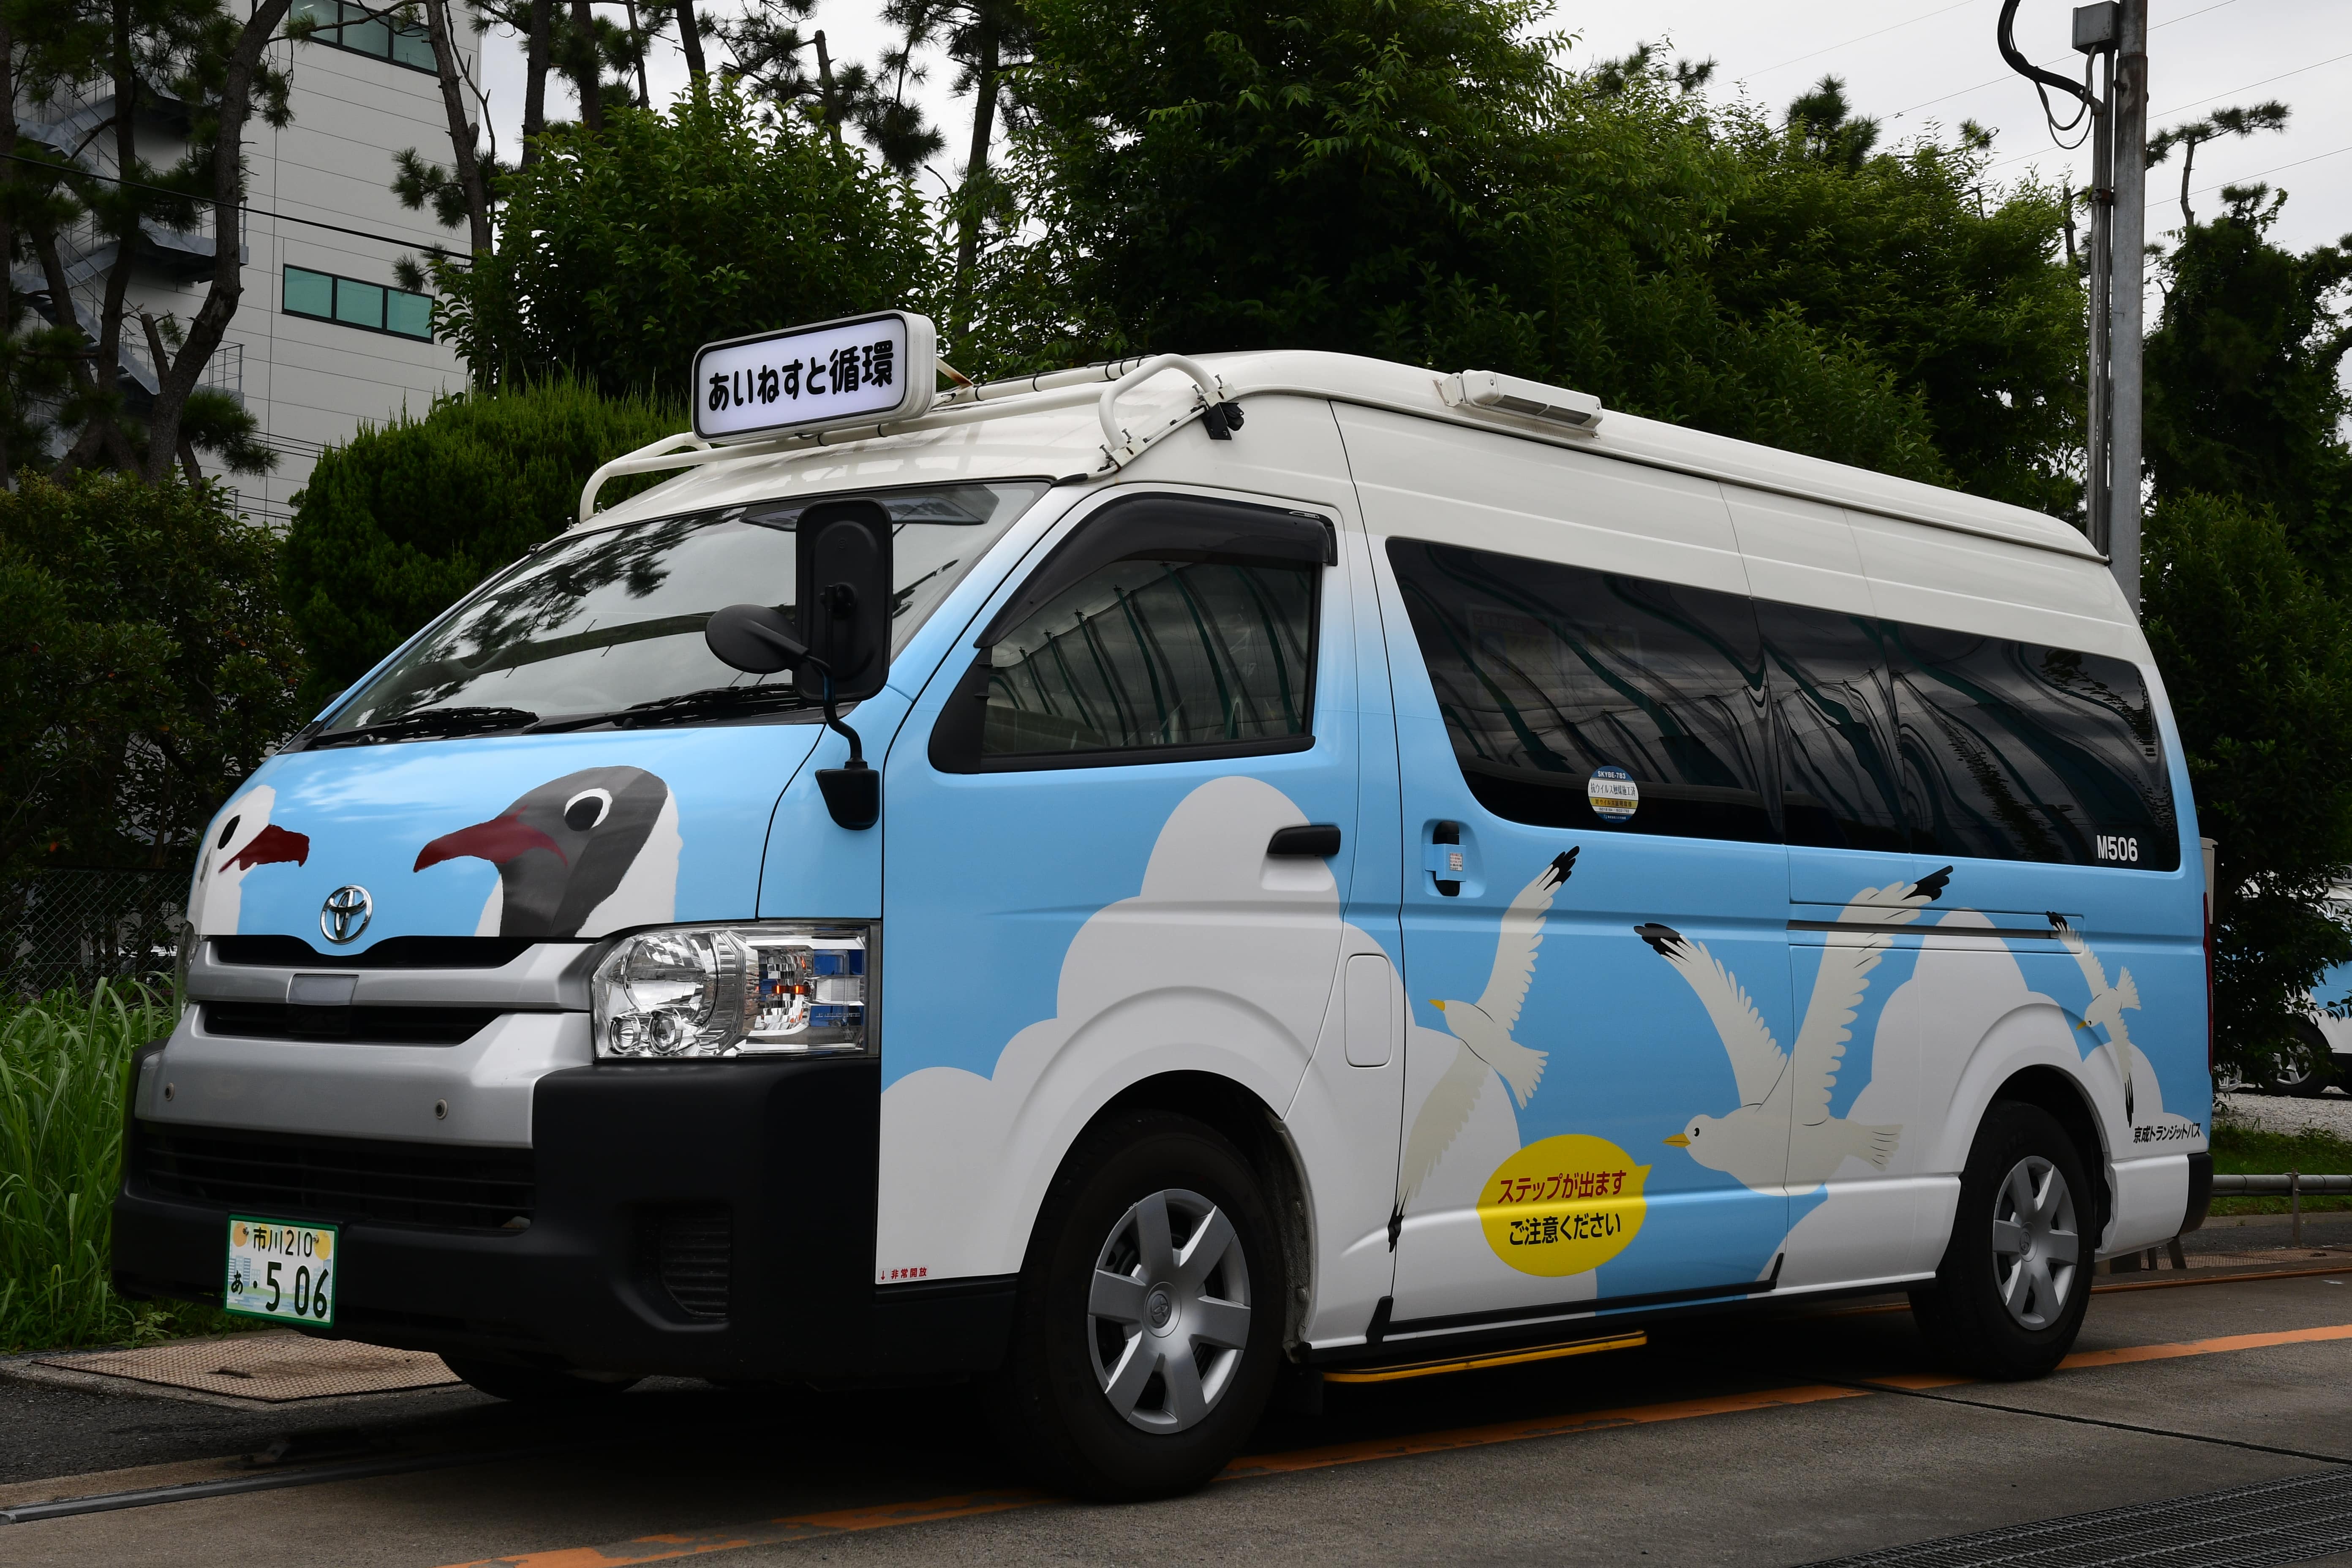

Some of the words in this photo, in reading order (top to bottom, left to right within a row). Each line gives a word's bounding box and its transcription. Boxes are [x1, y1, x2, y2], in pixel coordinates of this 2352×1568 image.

[708, 340, 894, 411] あいねすと循環
[1598, 771, 1626, 779] SKYBE-783
[2096, 835, 2138, 862] M506
[2133, 1122, 2201, 1144] 京成トランジットバス
[1497, 1169, 1627, 1204] ステップが出ます
[1509, 1212, 1621, 1246] ご注意ください
[231, 1269, 243, 1295] あ
[890, 1267, 927, 1280] 非常開放
